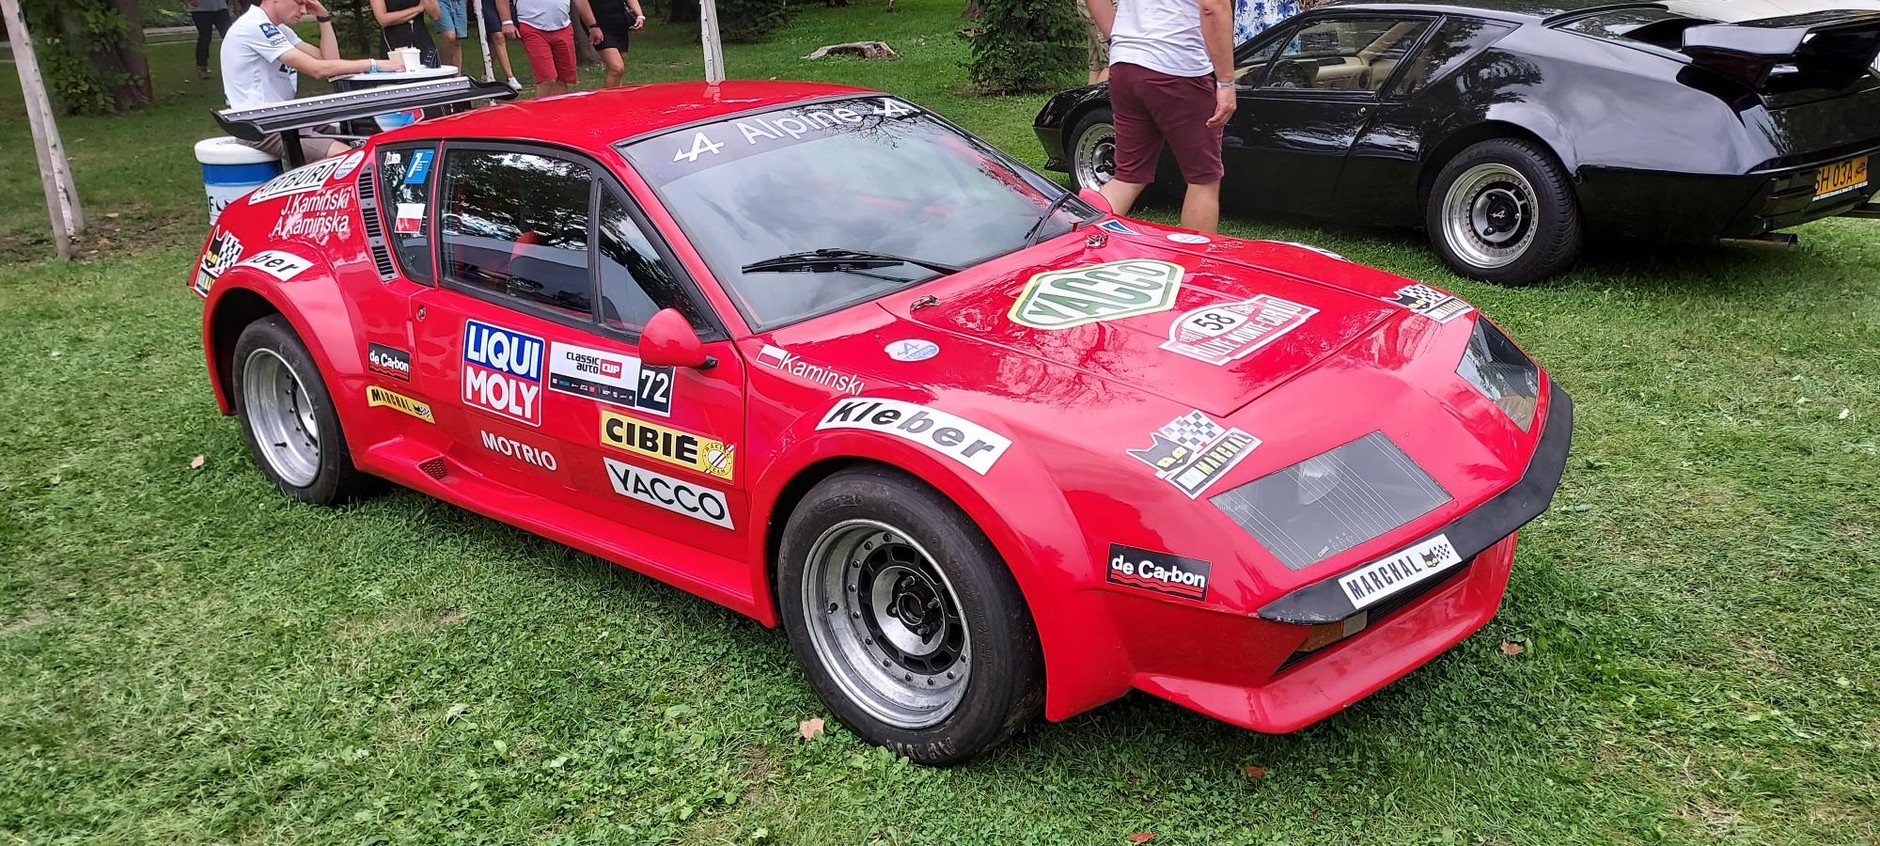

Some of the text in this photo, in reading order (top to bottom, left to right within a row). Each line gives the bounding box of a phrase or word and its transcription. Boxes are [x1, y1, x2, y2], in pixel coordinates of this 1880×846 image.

[736, 106, 863, 145] Alpine
[1027, 264, 1166, 320] YACCO
[1192, 313, 1236, 331] 58
[369, 350, 410, 373] de Carbon
[467, 325, 540, 378] LIQUI
[602, 362, 620, 374] CUP
[466, 366, 539, 419] MOLY
[641, 369, 669, 404] 72
[780, 352, 865, 396] Kaminski
[480, 430, 557, 471] MOTRIO
[826, 401, 995, 459] Kleber
[1194, 432, 1253, 476] MARCHAL
[608, 463, 726, 520] YACCO
[1111, 554, 1205, 588] de Carbon
[1346, 555, 1423, 600] MARCHAL
